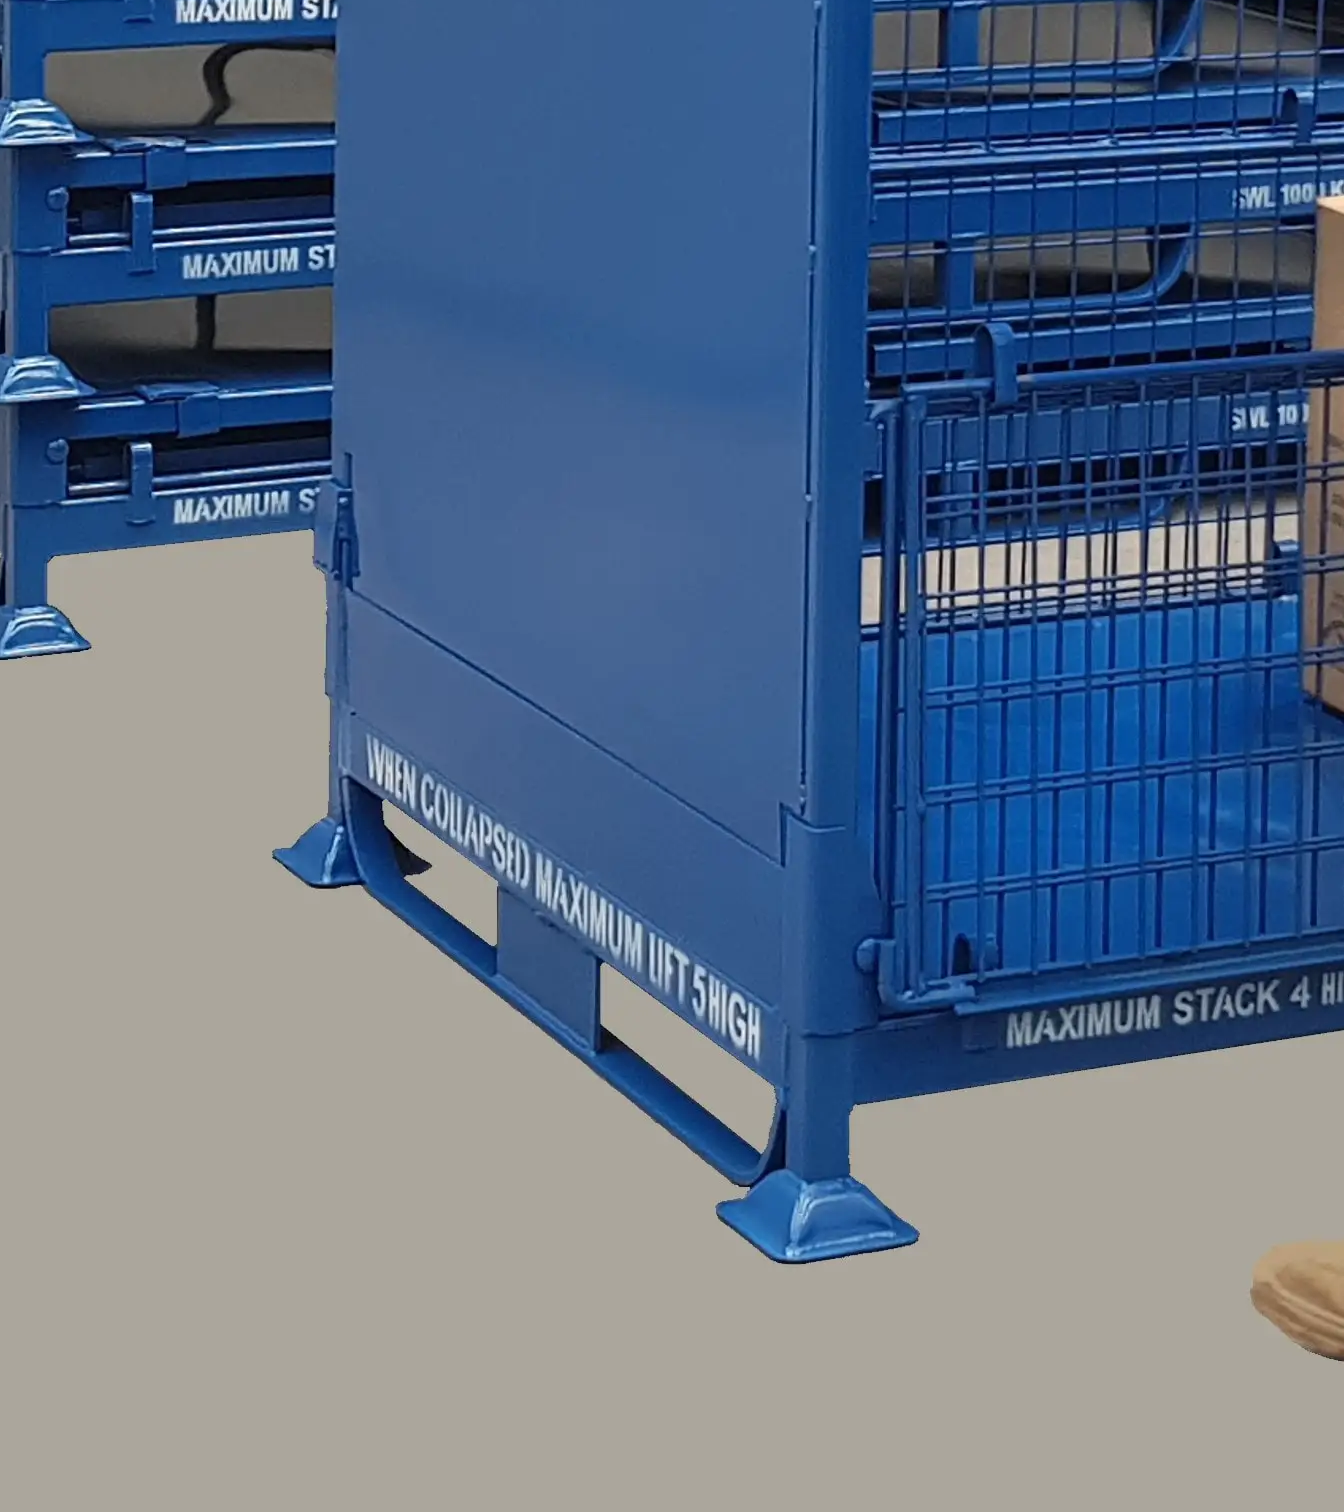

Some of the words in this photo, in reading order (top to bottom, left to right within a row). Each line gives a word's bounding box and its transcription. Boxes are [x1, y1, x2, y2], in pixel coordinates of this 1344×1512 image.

[182, 247, 299, 279] MAXIMUM
[173, 490, 290, 524] MAXIMUM
[365, 733, 417, 809] WHEN
[420, 772, 529, 890] COLLAPSED
[535, 852, 643, 973] MAXIMUM
[649, 933, 690, 1002] LIFT
[692, 966, 707, 1022] 5
[709, 975, 761, 1061] HIGH
[1006, 994, 1161, 1049] MAXIMUM
[1173, 979, 1280, 1026] STACK
[1289, 976, 1312, 1010] 4
